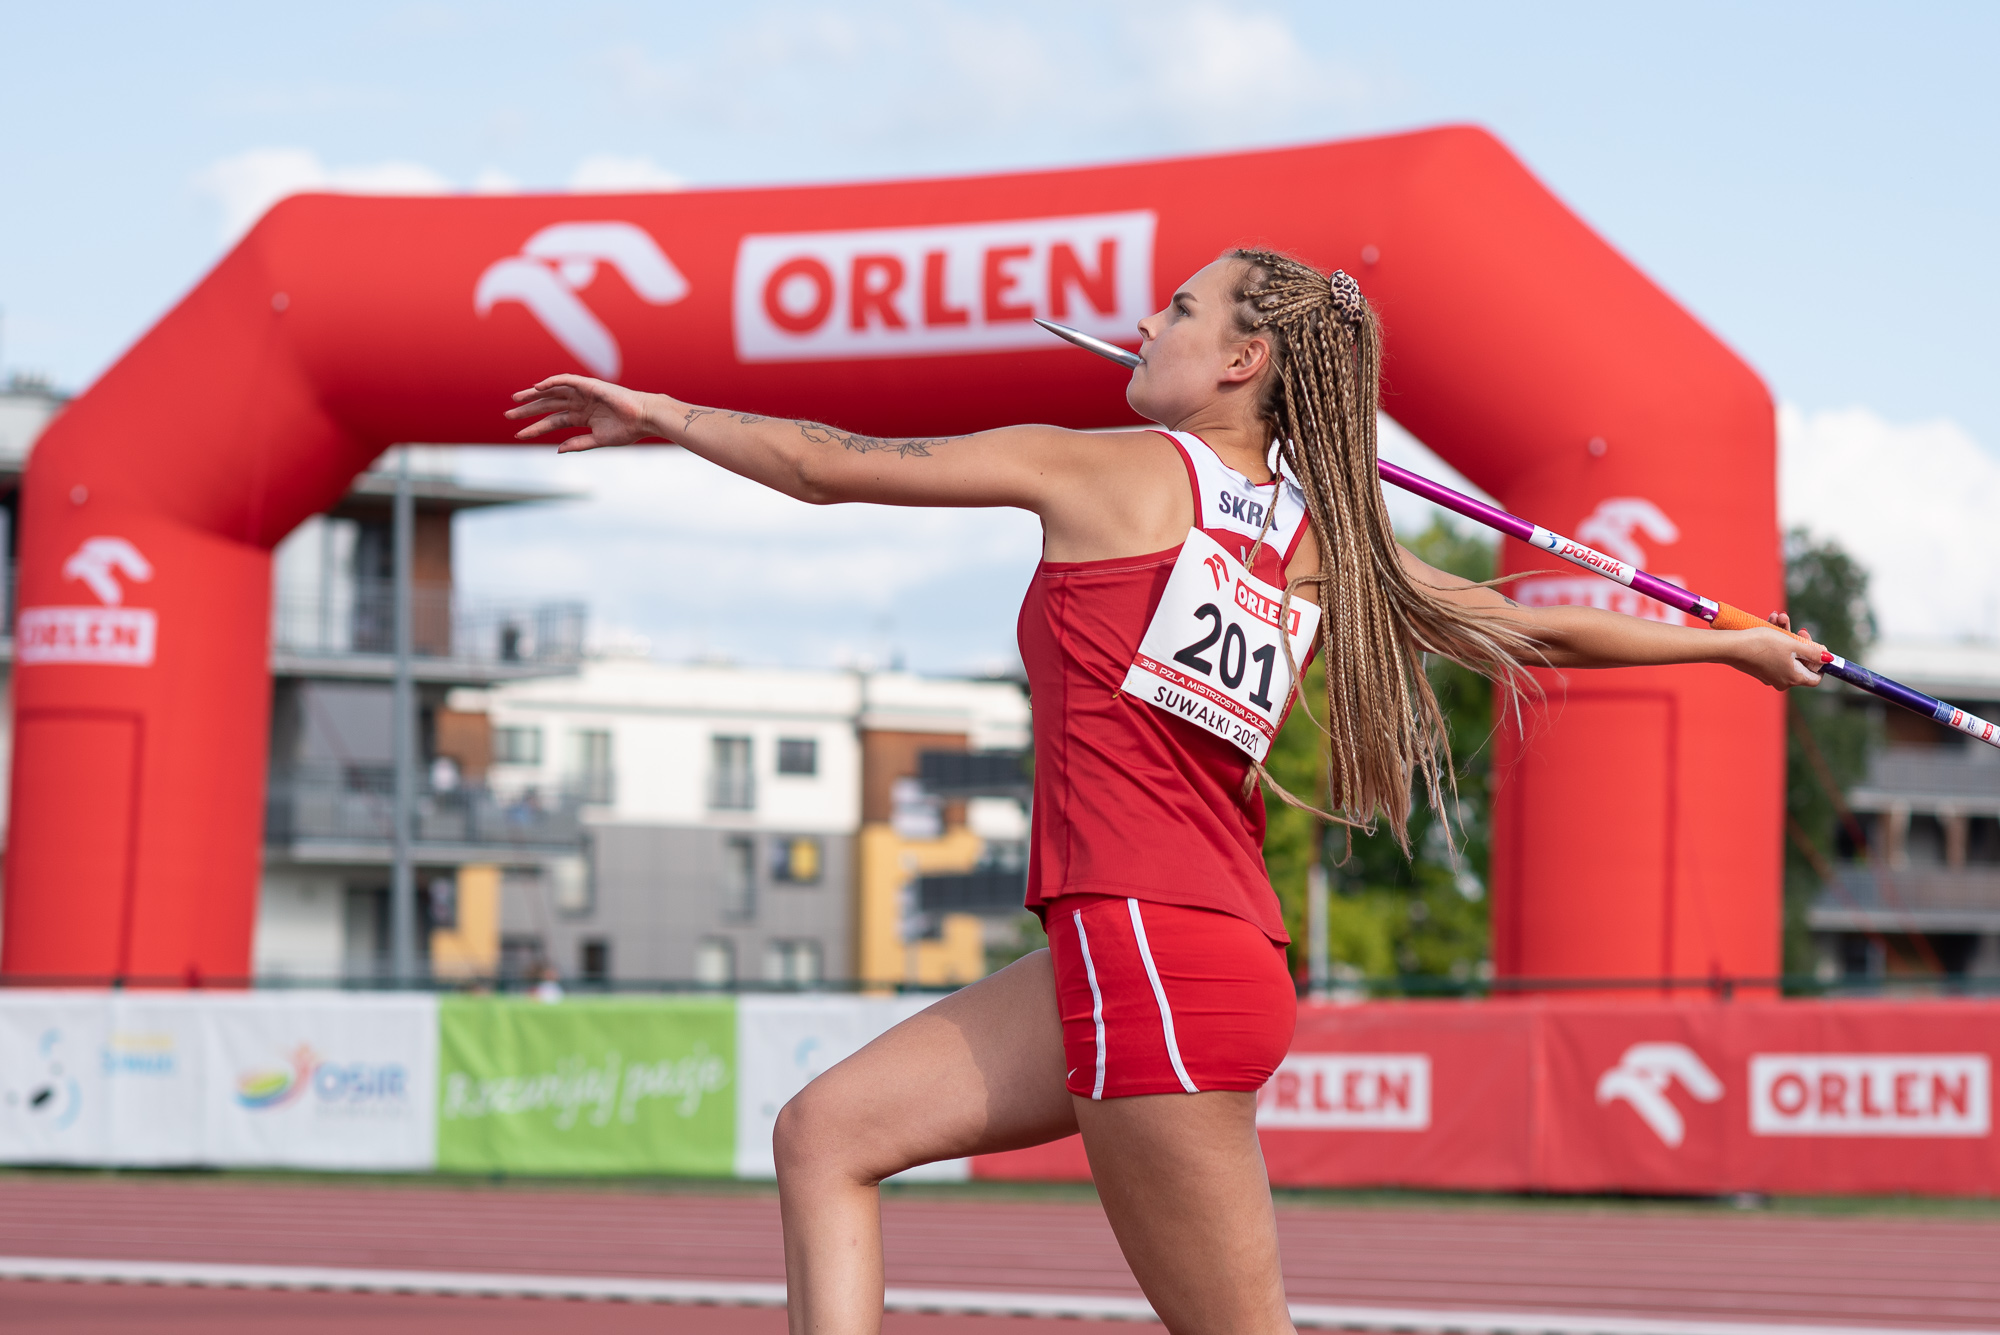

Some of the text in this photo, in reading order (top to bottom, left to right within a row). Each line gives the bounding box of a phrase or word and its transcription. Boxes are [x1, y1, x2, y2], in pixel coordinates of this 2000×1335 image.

[762, 239, 1122, 338] ORLEN
[1559, 542, 1625, 577] polanik
[1173, 602, 1277, 713] 201
[1141, 658, 1157, 672] 38.
[1159, 667, 1186, 685] PZLA
[1187, 680, 1245, 717] MISTRZOSTWA
[1154, 686, 1259, 753] SUWAŁKI 2021
[1257, 1070, 1410, 1112] RLEN
[1767, 1070, 1972, 1121] ORLEN
